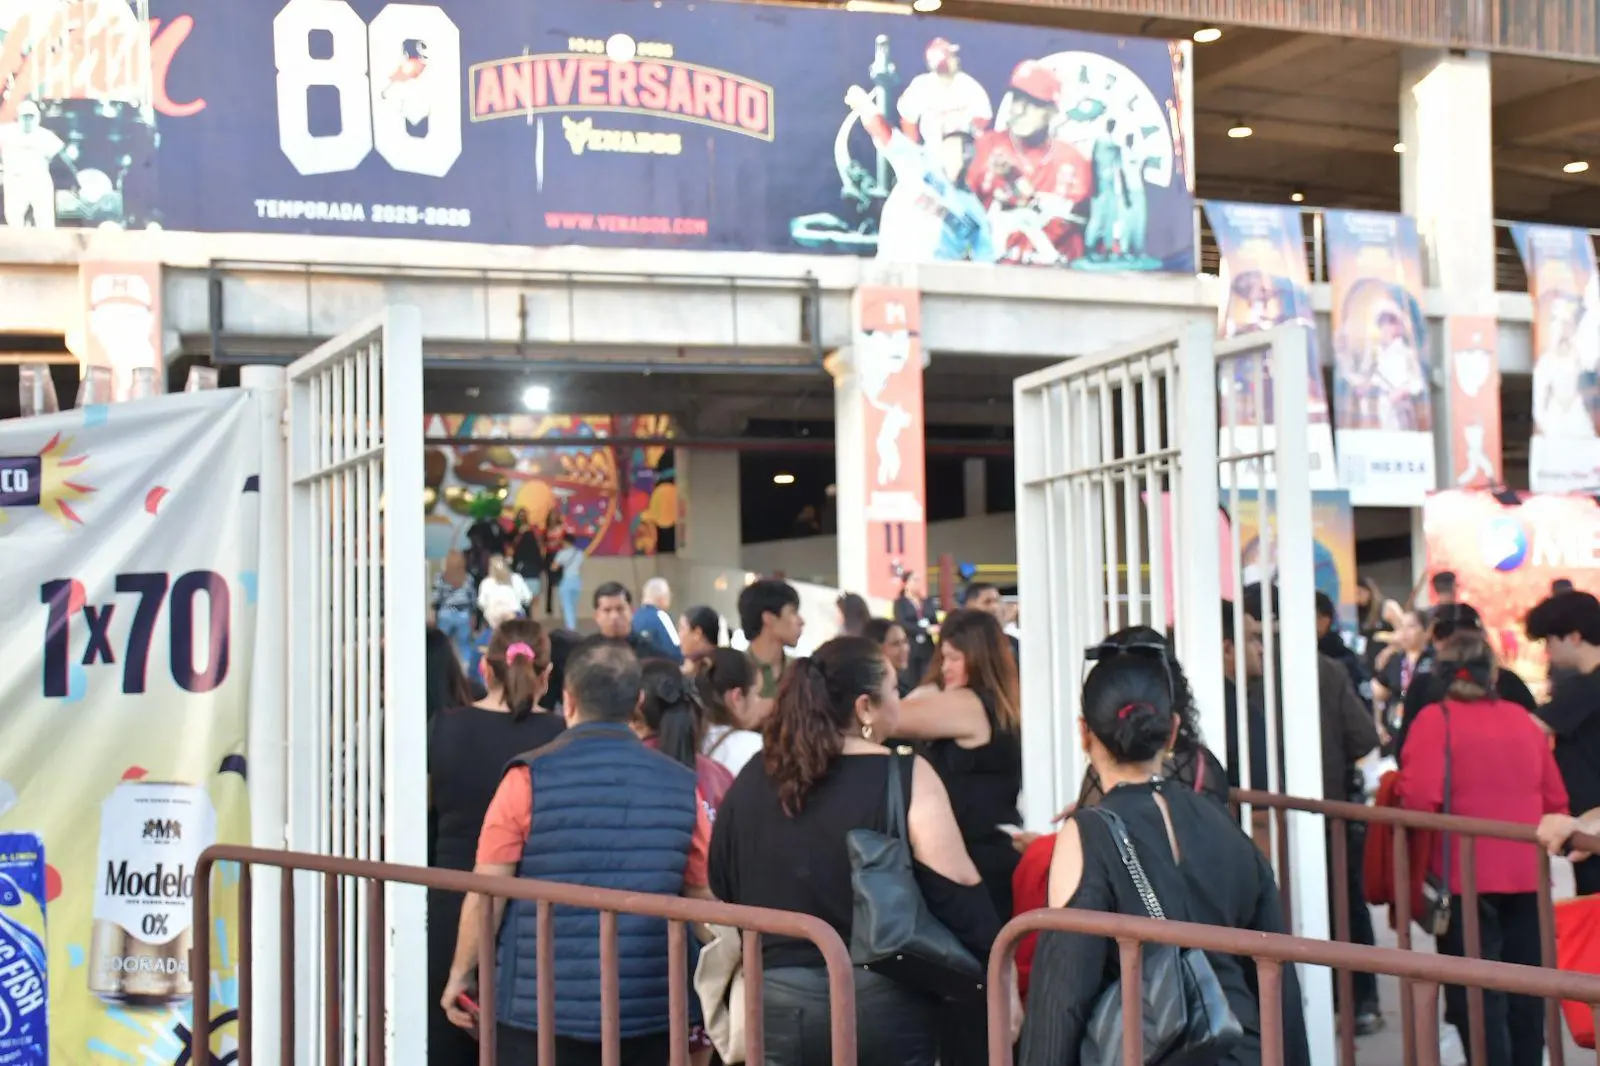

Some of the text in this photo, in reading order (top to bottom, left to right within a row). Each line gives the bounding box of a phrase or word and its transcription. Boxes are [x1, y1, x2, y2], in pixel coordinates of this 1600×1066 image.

[272, 0, 463, 178] 80
[475, 57, 768, 133] ANIVERSARIO
[254, 199, 366, 221] TEMPORADA
[40, 569, 231, 698] 1x70
[105, 861, 194, 898] Modelo
[141, 913, 169, 937] 0%
[0, 959, 44, 1016] FISH
